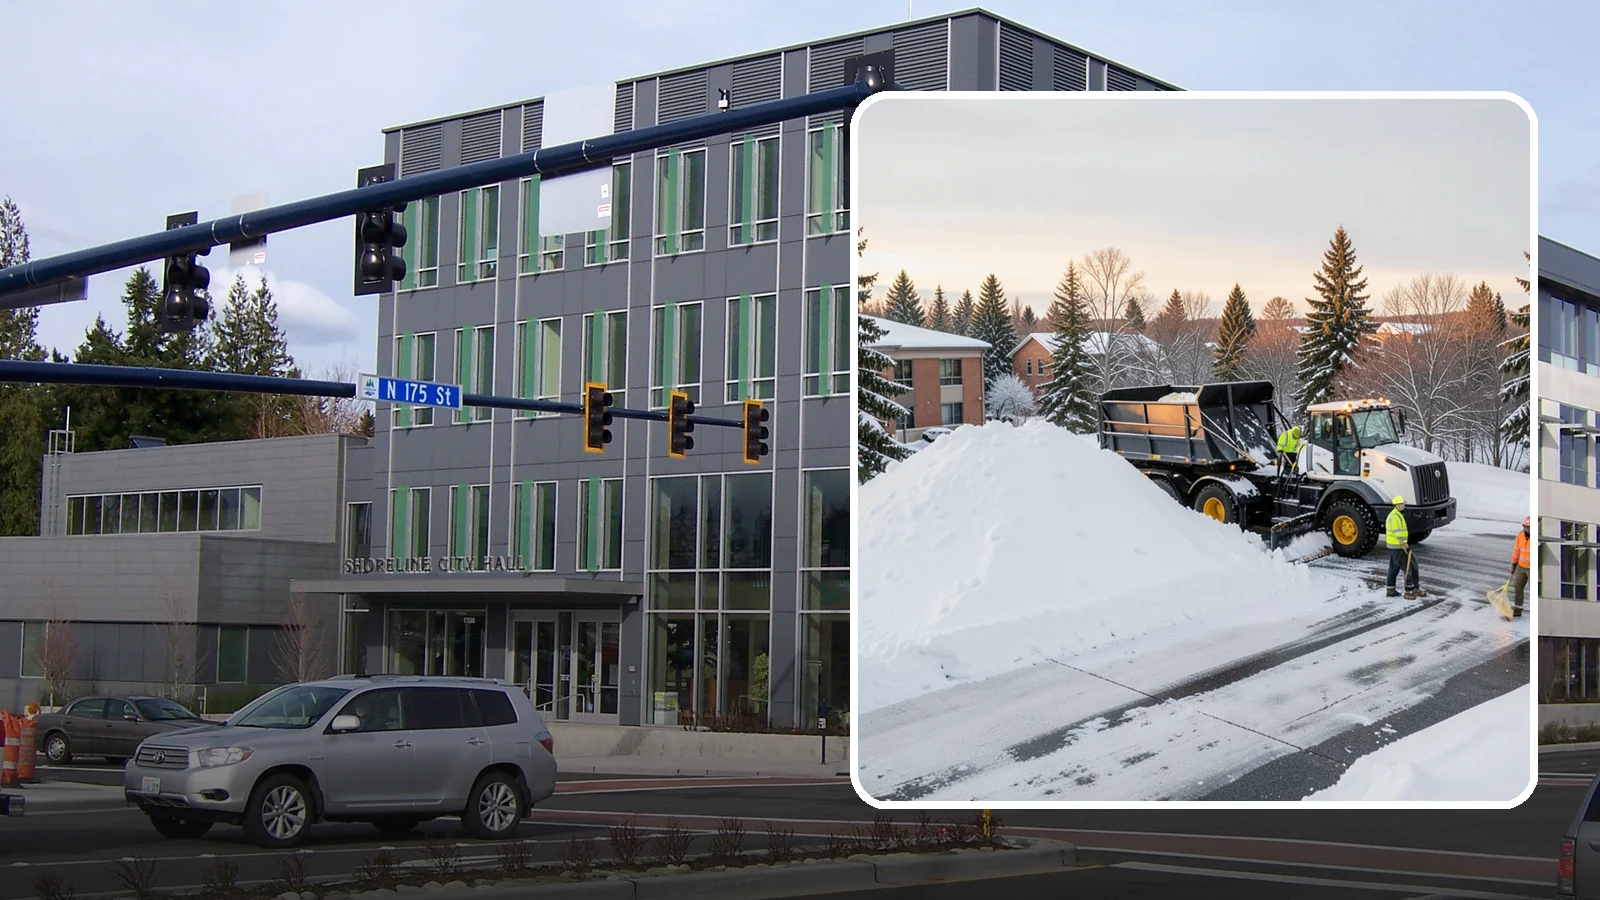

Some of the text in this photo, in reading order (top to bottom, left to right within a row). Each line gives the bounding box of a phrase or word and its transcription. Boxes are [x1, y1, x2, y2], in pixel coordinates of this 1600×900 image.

[387, 380, 451, 406] N 175 St
[344, 556, 526, 574] SHORELINE CITY HALL
